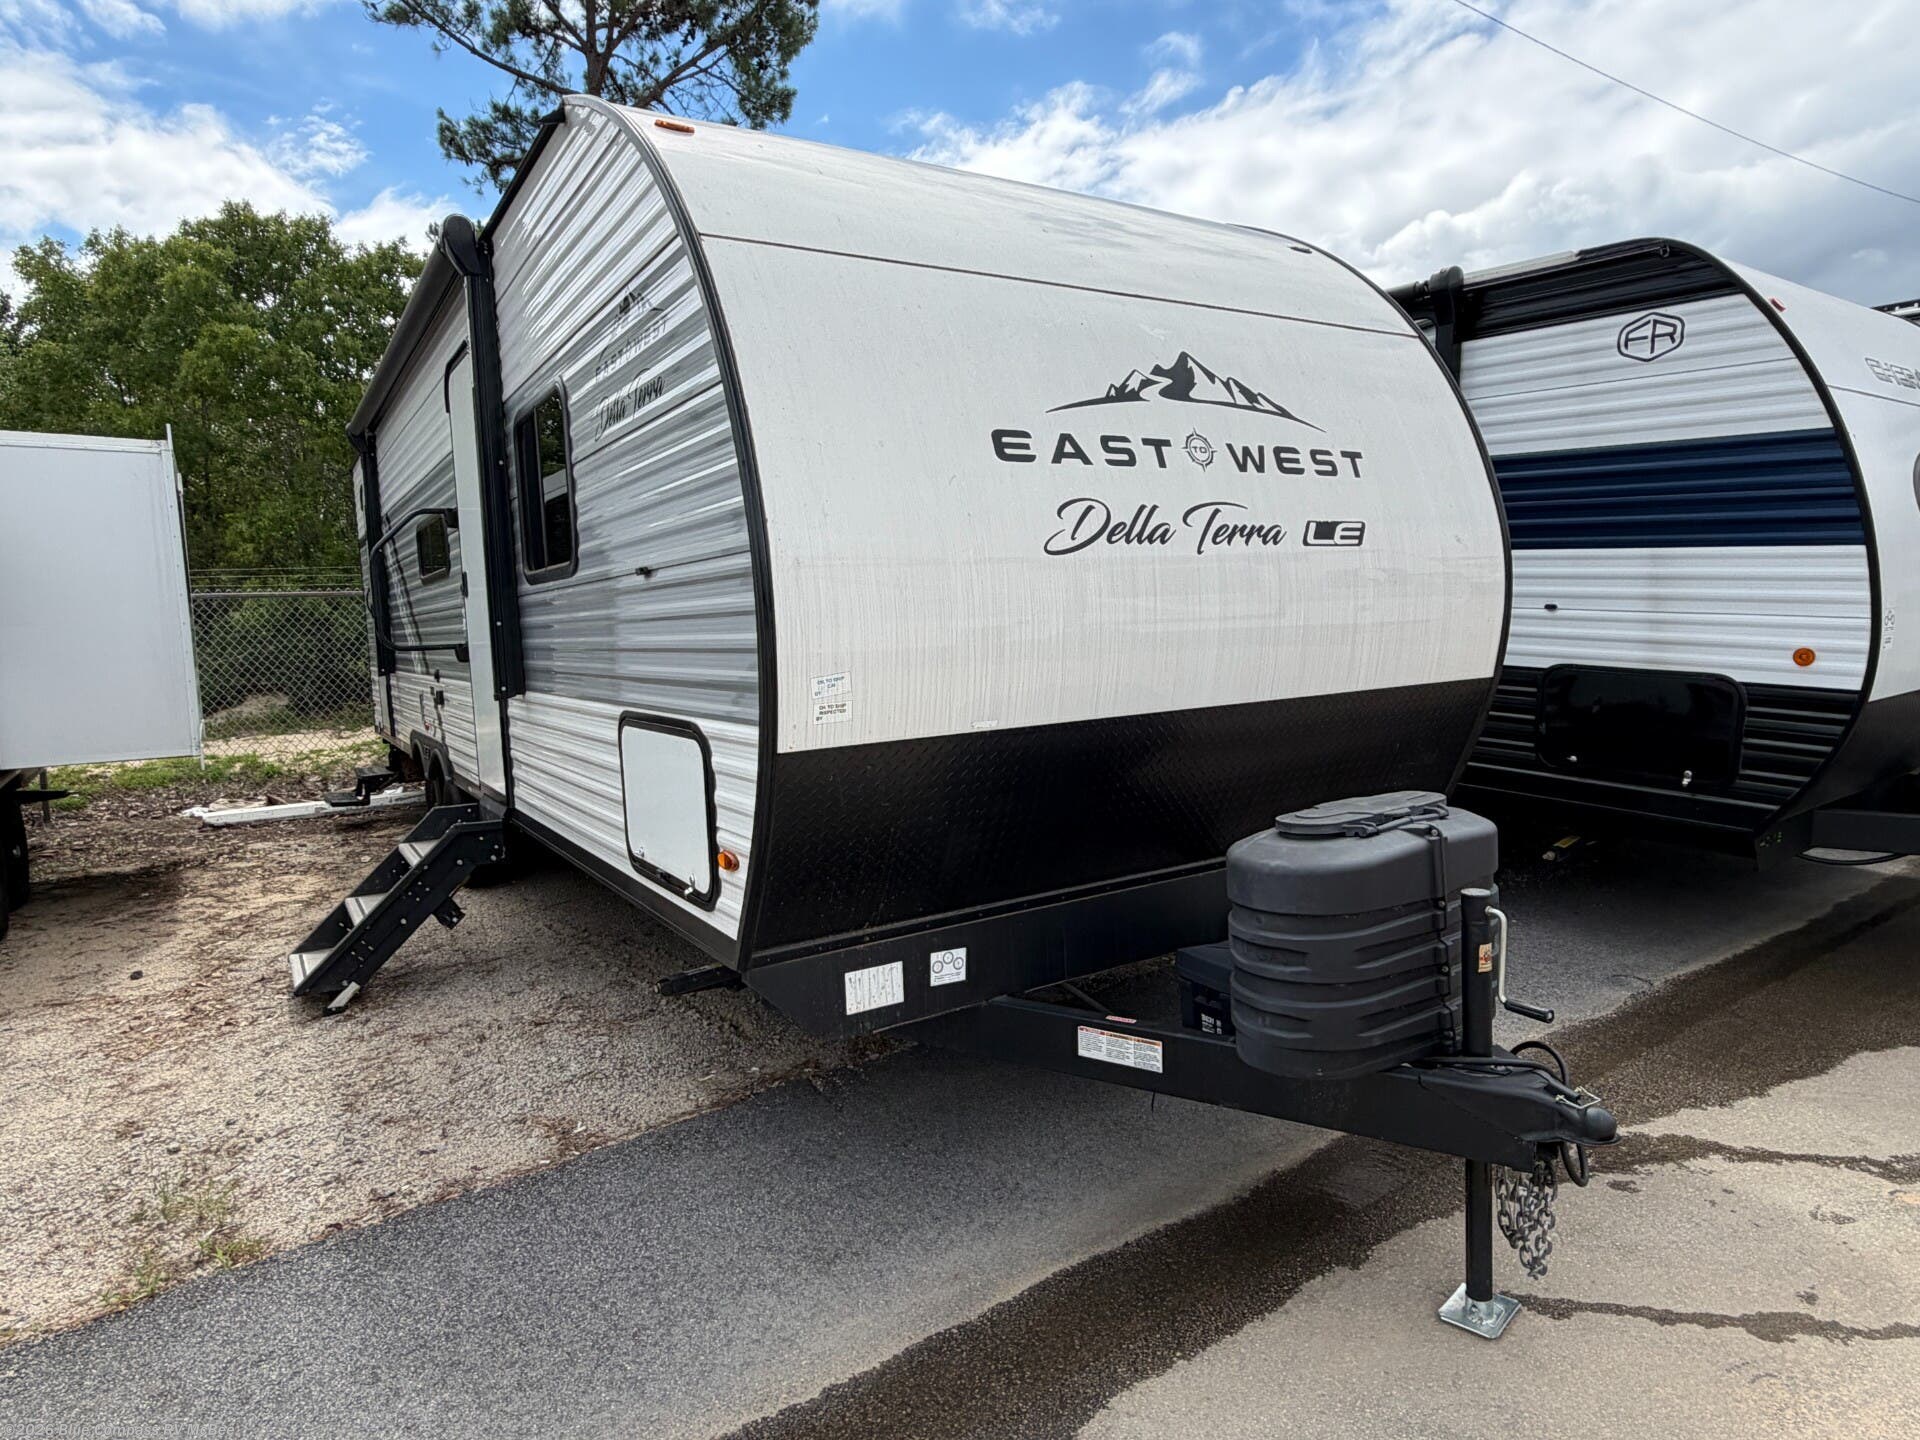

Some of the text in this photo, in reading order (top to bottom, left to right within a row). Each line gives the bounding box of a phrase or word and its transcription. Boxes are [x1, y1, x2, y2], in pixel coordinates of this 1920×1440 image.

[1623, 318, 1678, 354] FR
[594, 367, 666, 443] Della Terra
[990, 428, 1173, 469] EAST
[1224, 441, 1363, 479] WEST
[1043, 497, 1366, 556] Della Terra LE
